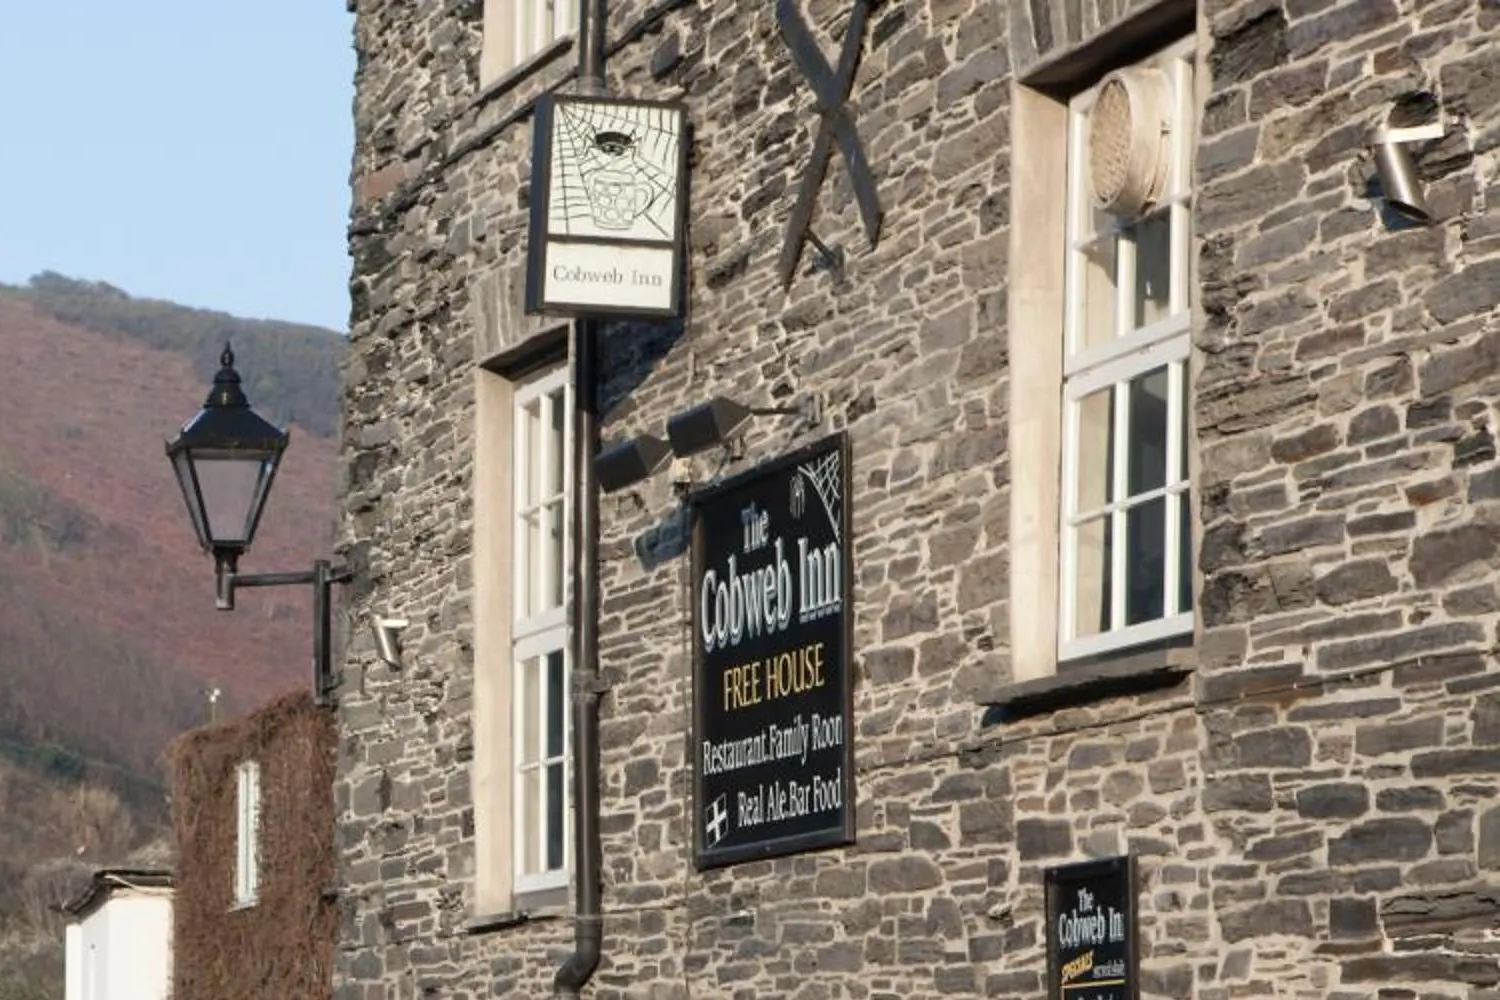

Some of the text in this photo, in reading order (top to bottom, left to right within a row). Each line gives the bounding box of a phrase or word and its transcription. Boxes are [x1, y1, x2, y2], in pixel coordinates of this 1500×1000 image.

[553, 265, 663, 287] Cobweb Inn
[741, 502, 769, 553] The
[701, 536, 842, 653] Cobweb Inn
[723, 642, 825, 712] FREE HOUSE
[737, 784, 764, 828] Real
[813, 767, 842, 812] Food
[1078, 887, 1094, 912] The
[1060, 905, 1105, 948] Cobweb
